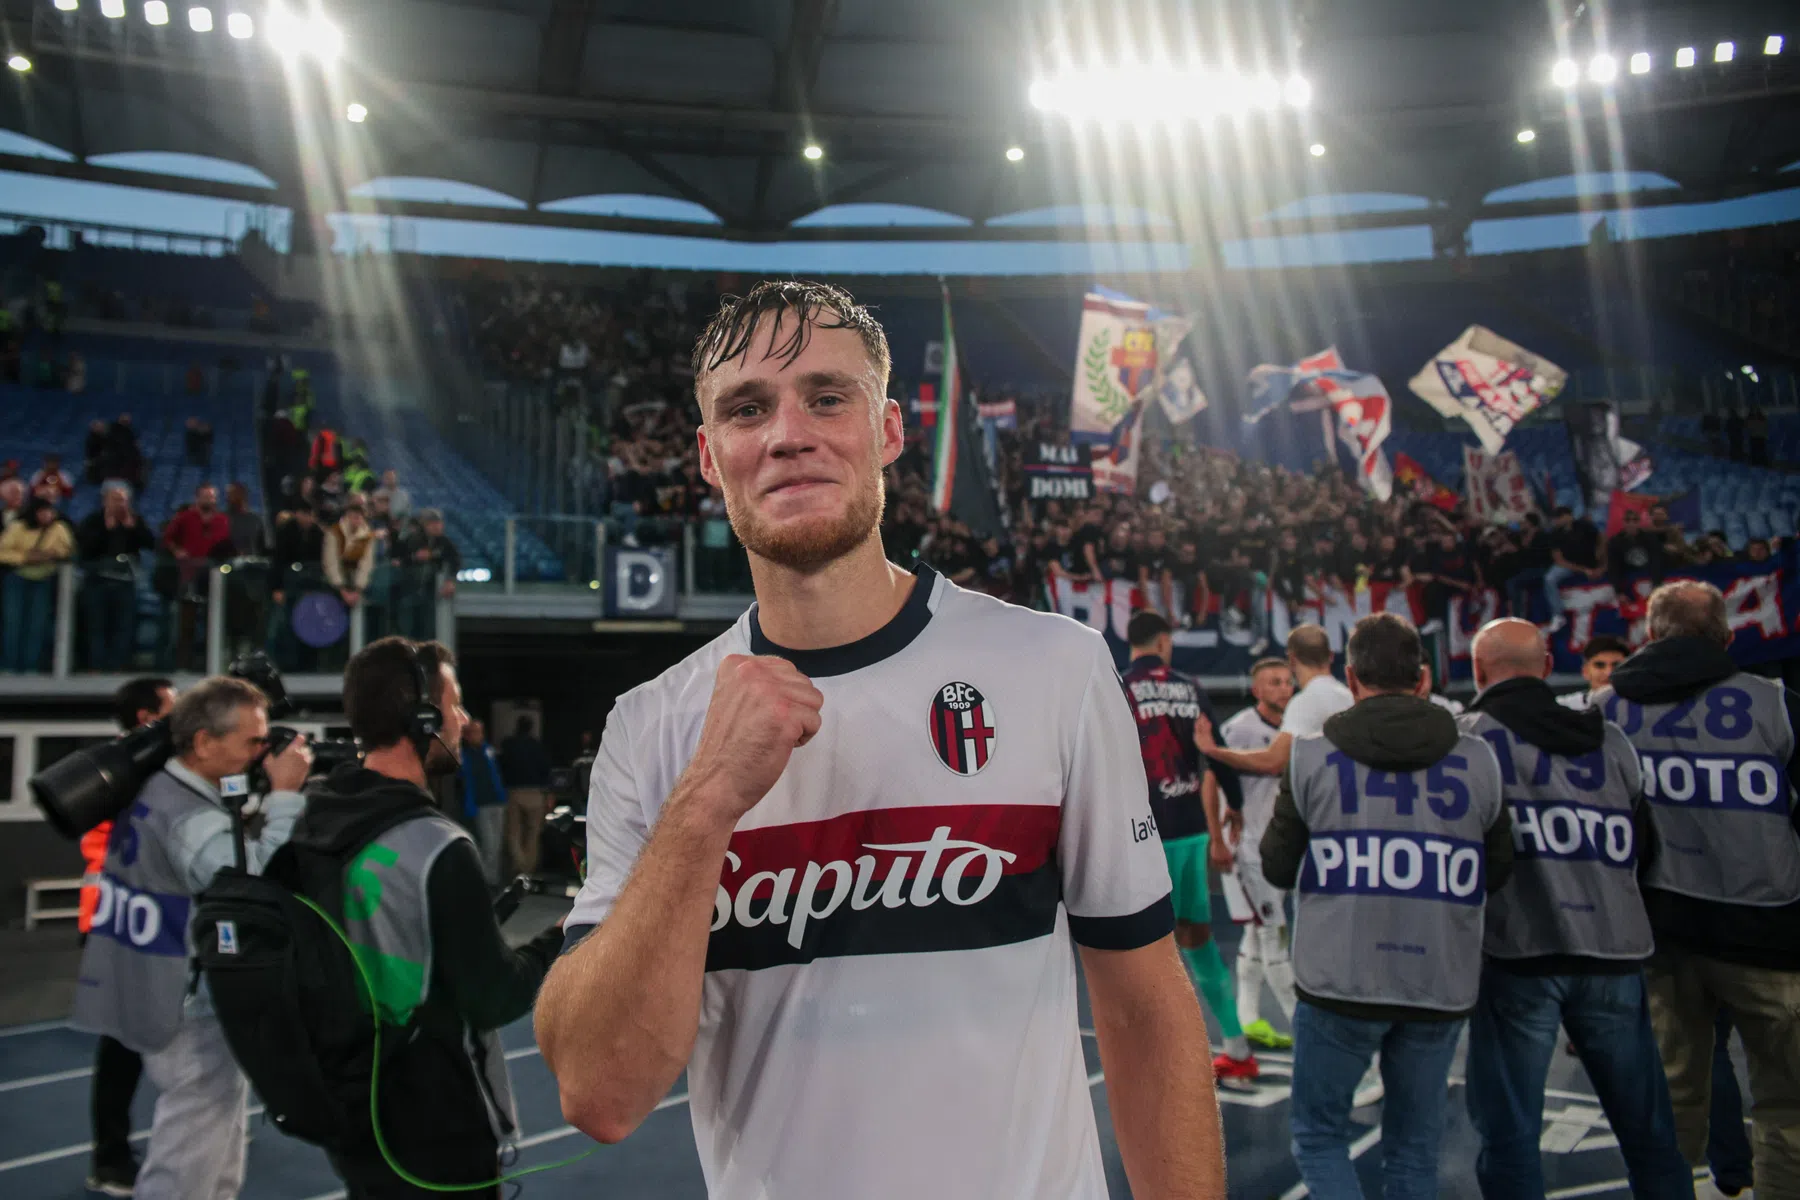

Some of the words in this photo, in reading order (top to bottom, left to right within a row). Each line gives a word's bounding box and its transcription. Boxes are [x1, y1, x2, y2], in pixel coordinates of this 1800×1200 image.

[616, 551, 664, 610] D
[942, 682, 975, 702] BFC
[948, 701, 971, 710] 1909
[1326, 750, 1470, 821] 145
[1508, 805, 1634, 862] HOTO
[710, 825, 1017, 950] Saputo
[1310, 836, 1480, 897] PHOTO
